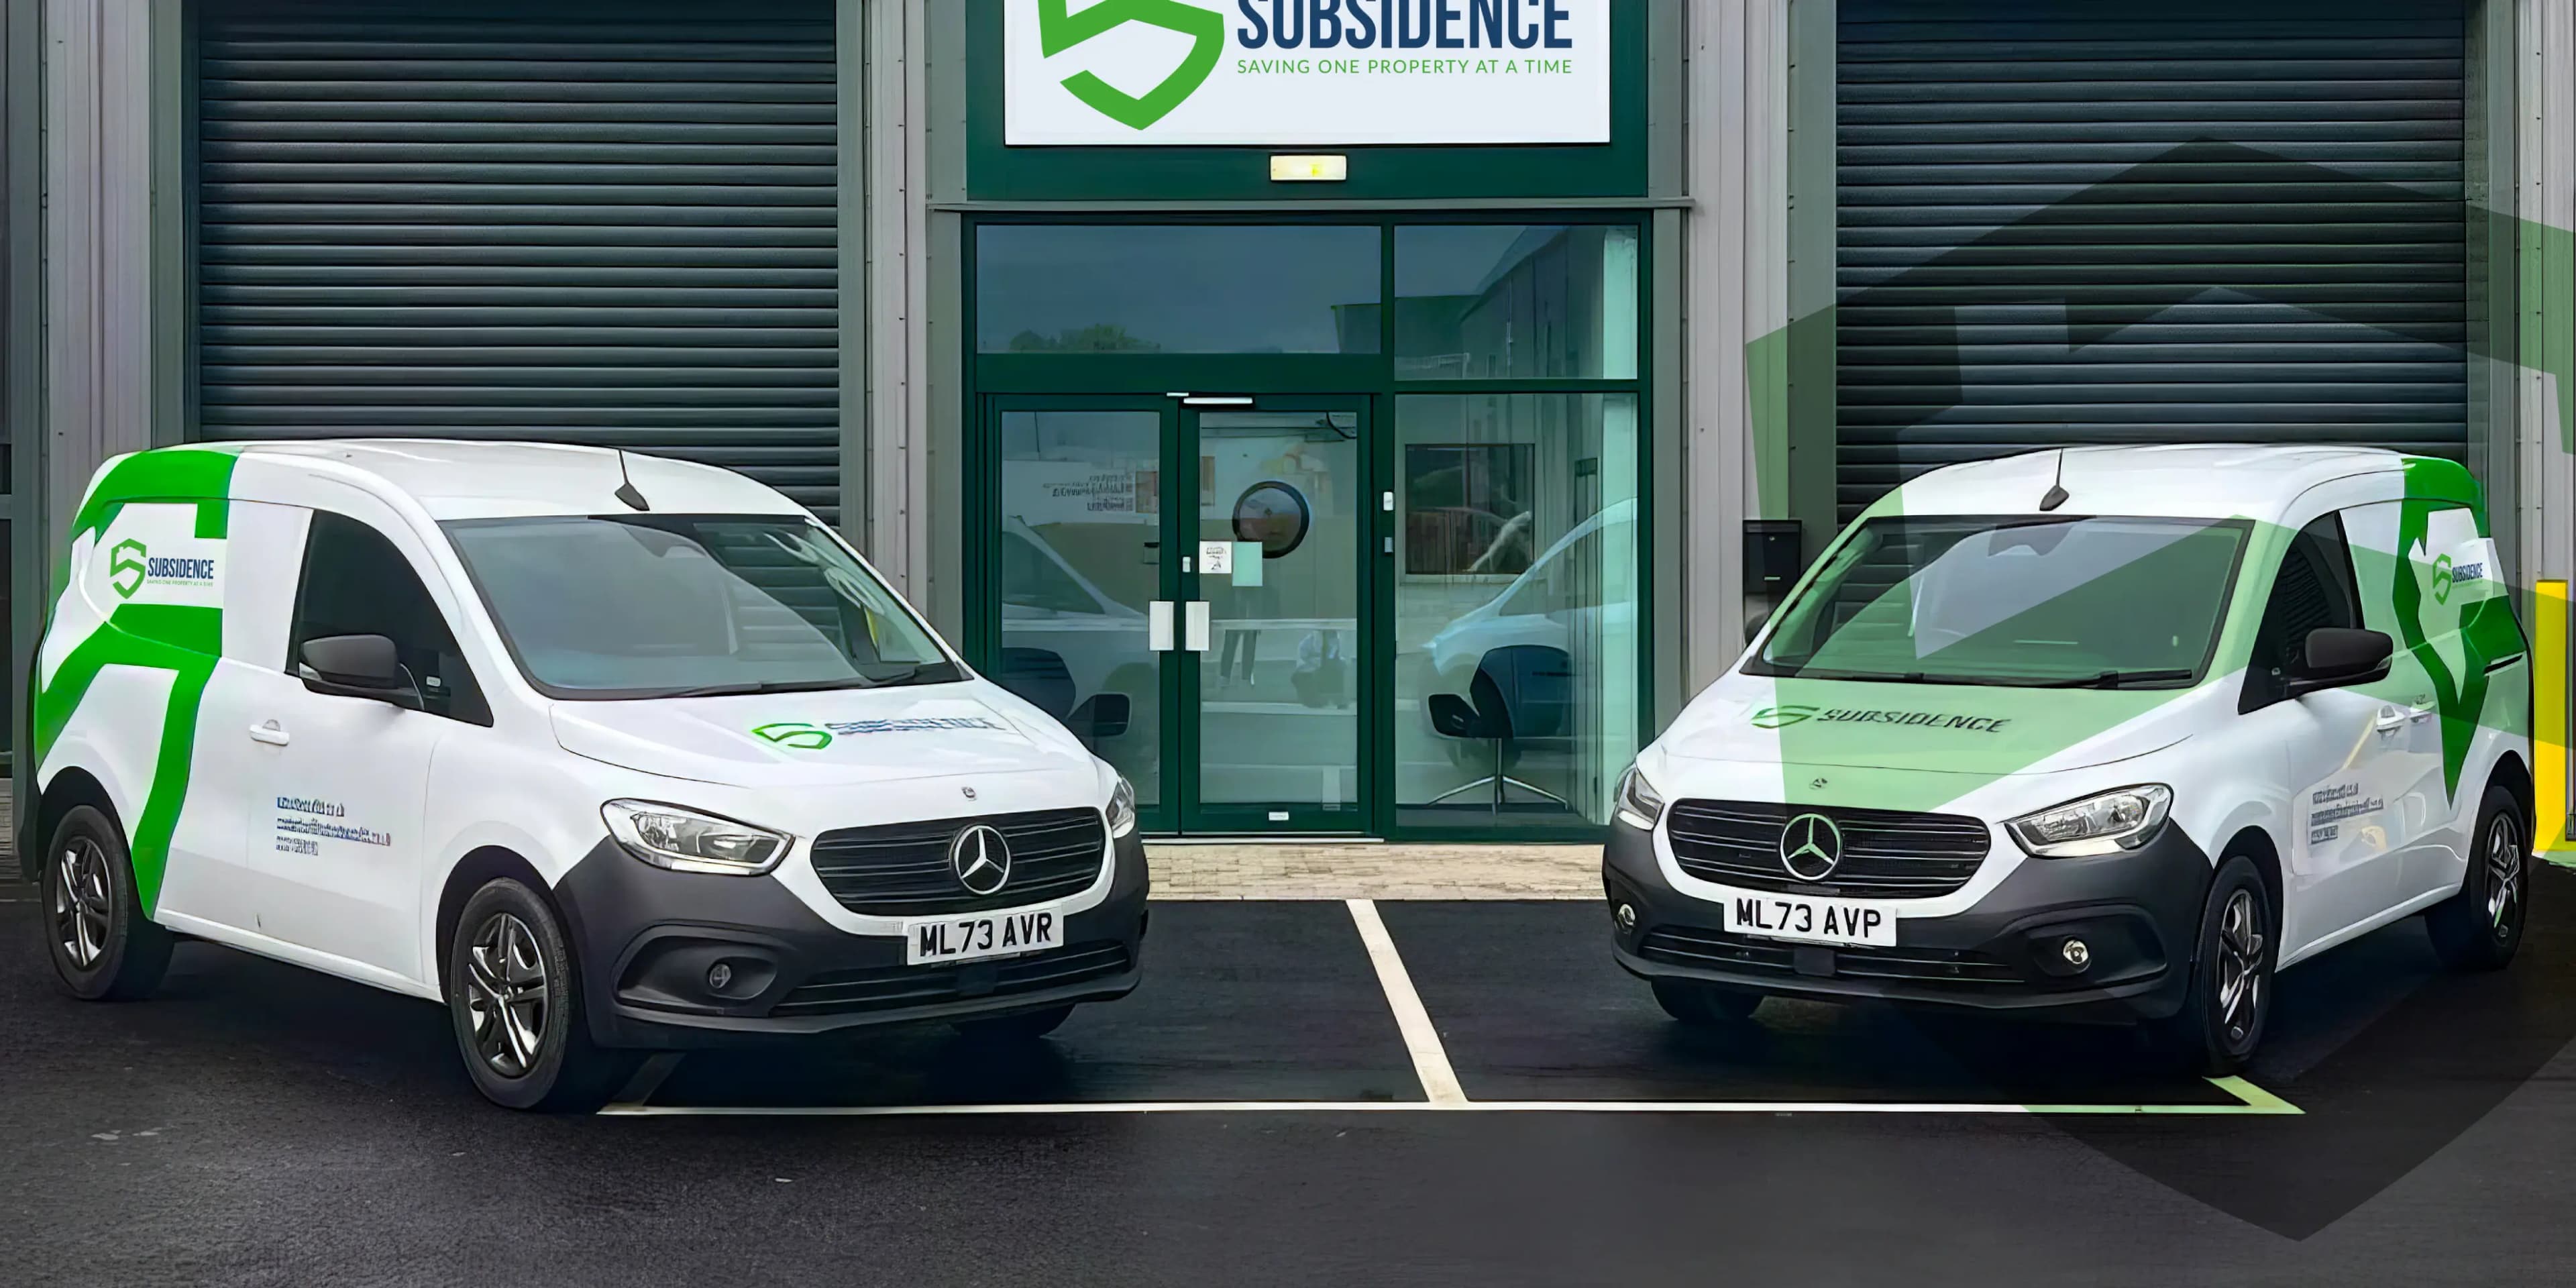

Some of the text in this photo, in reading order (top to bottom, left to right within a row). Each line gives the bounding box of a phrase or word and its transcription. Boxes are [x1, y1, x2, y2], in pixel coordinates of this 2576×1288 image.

[1238, 0, 1572, 49] SUBSIDENCE
[1238, 60, 1572, 74] SAVING ONE PROPERTY AT A TIME
[148, 557, 214, 579] SUBSIDENCE
[1817, 708, 2011, 733] SUBSIDENCE
[1737, 898, 1881, 938] ML73 AVP
[920, 912, 1052, 957] ML73 AVR
